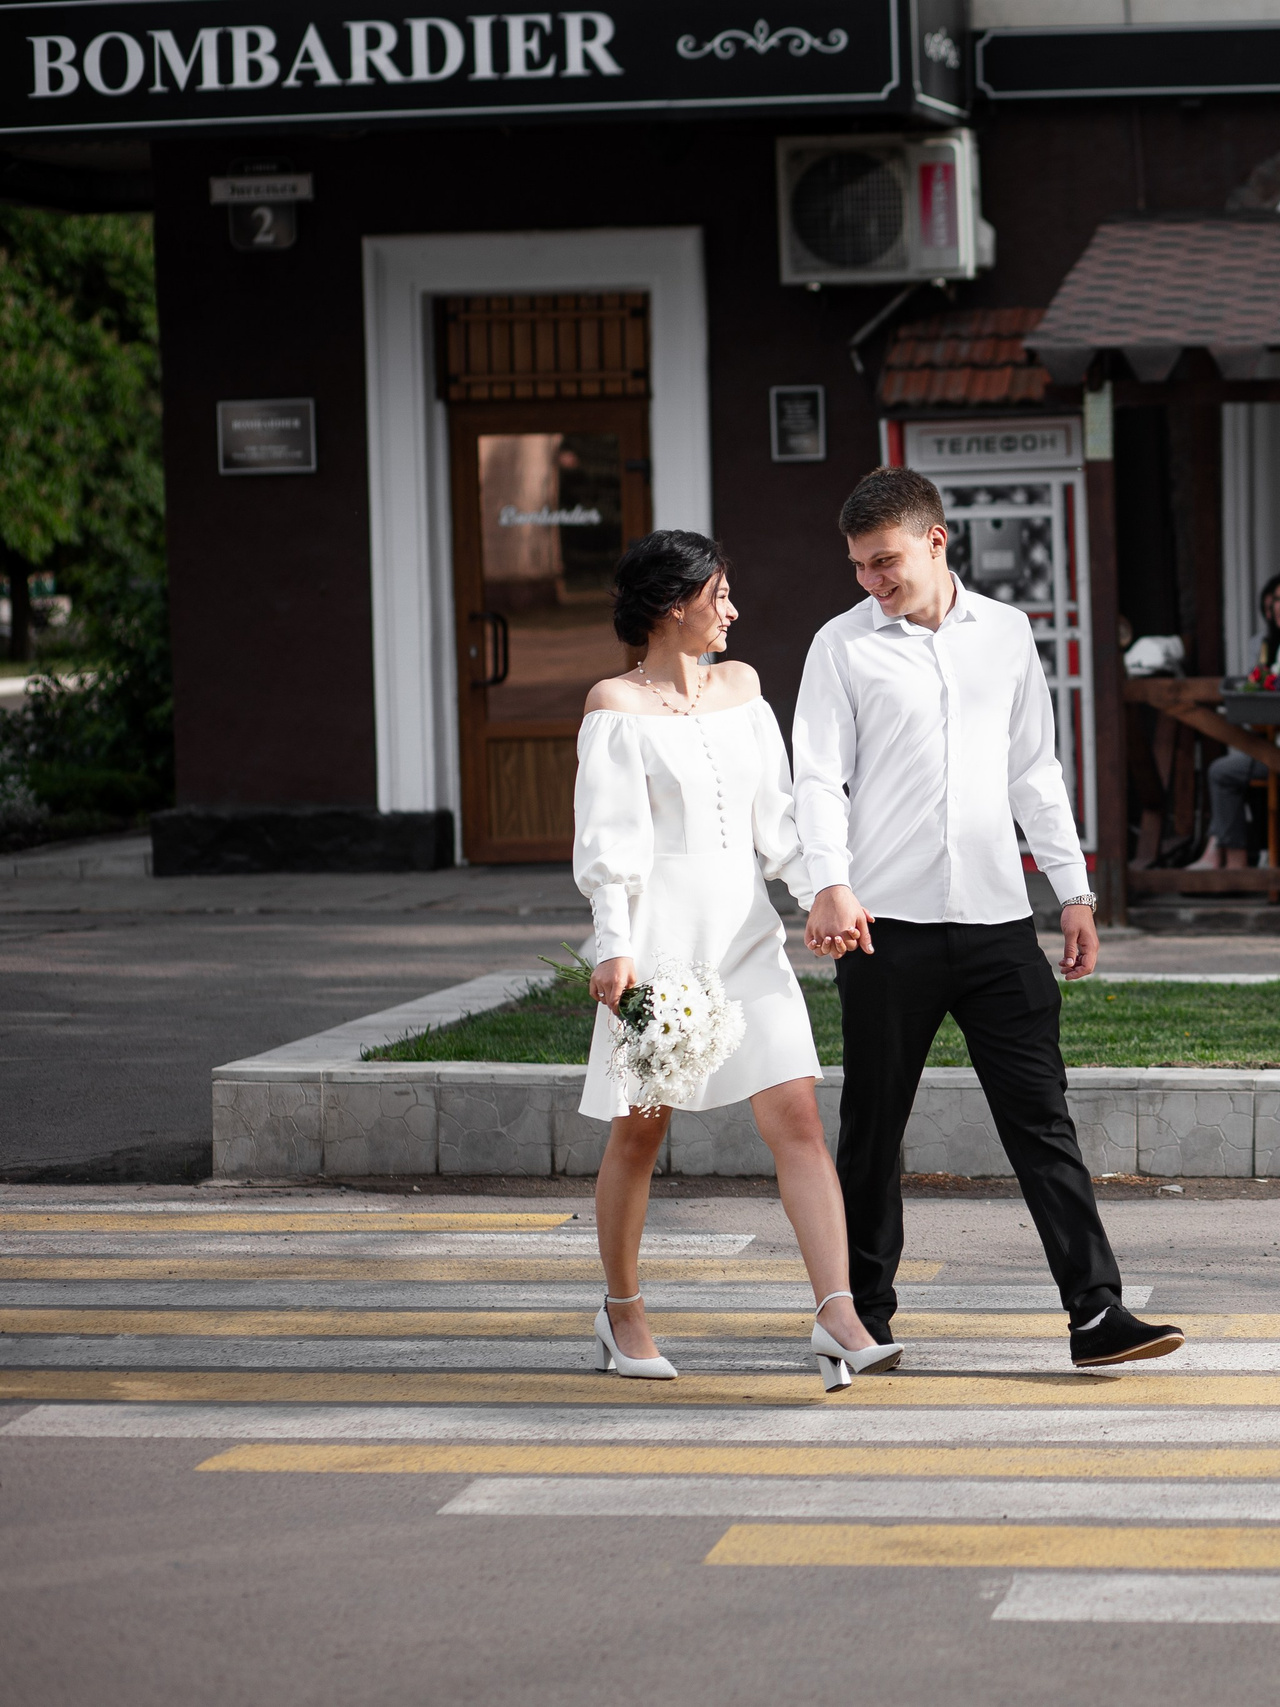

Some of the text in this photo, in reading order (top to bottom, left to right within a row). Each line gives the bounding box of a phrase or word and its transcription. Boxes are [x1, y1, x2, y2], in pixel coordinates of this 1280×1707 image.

[27, 11, 624, 99] BOMBARDIER
[251, 205, 276, 245] 2
[933, 434, 1058, 455] ТЕЛЕФОН
